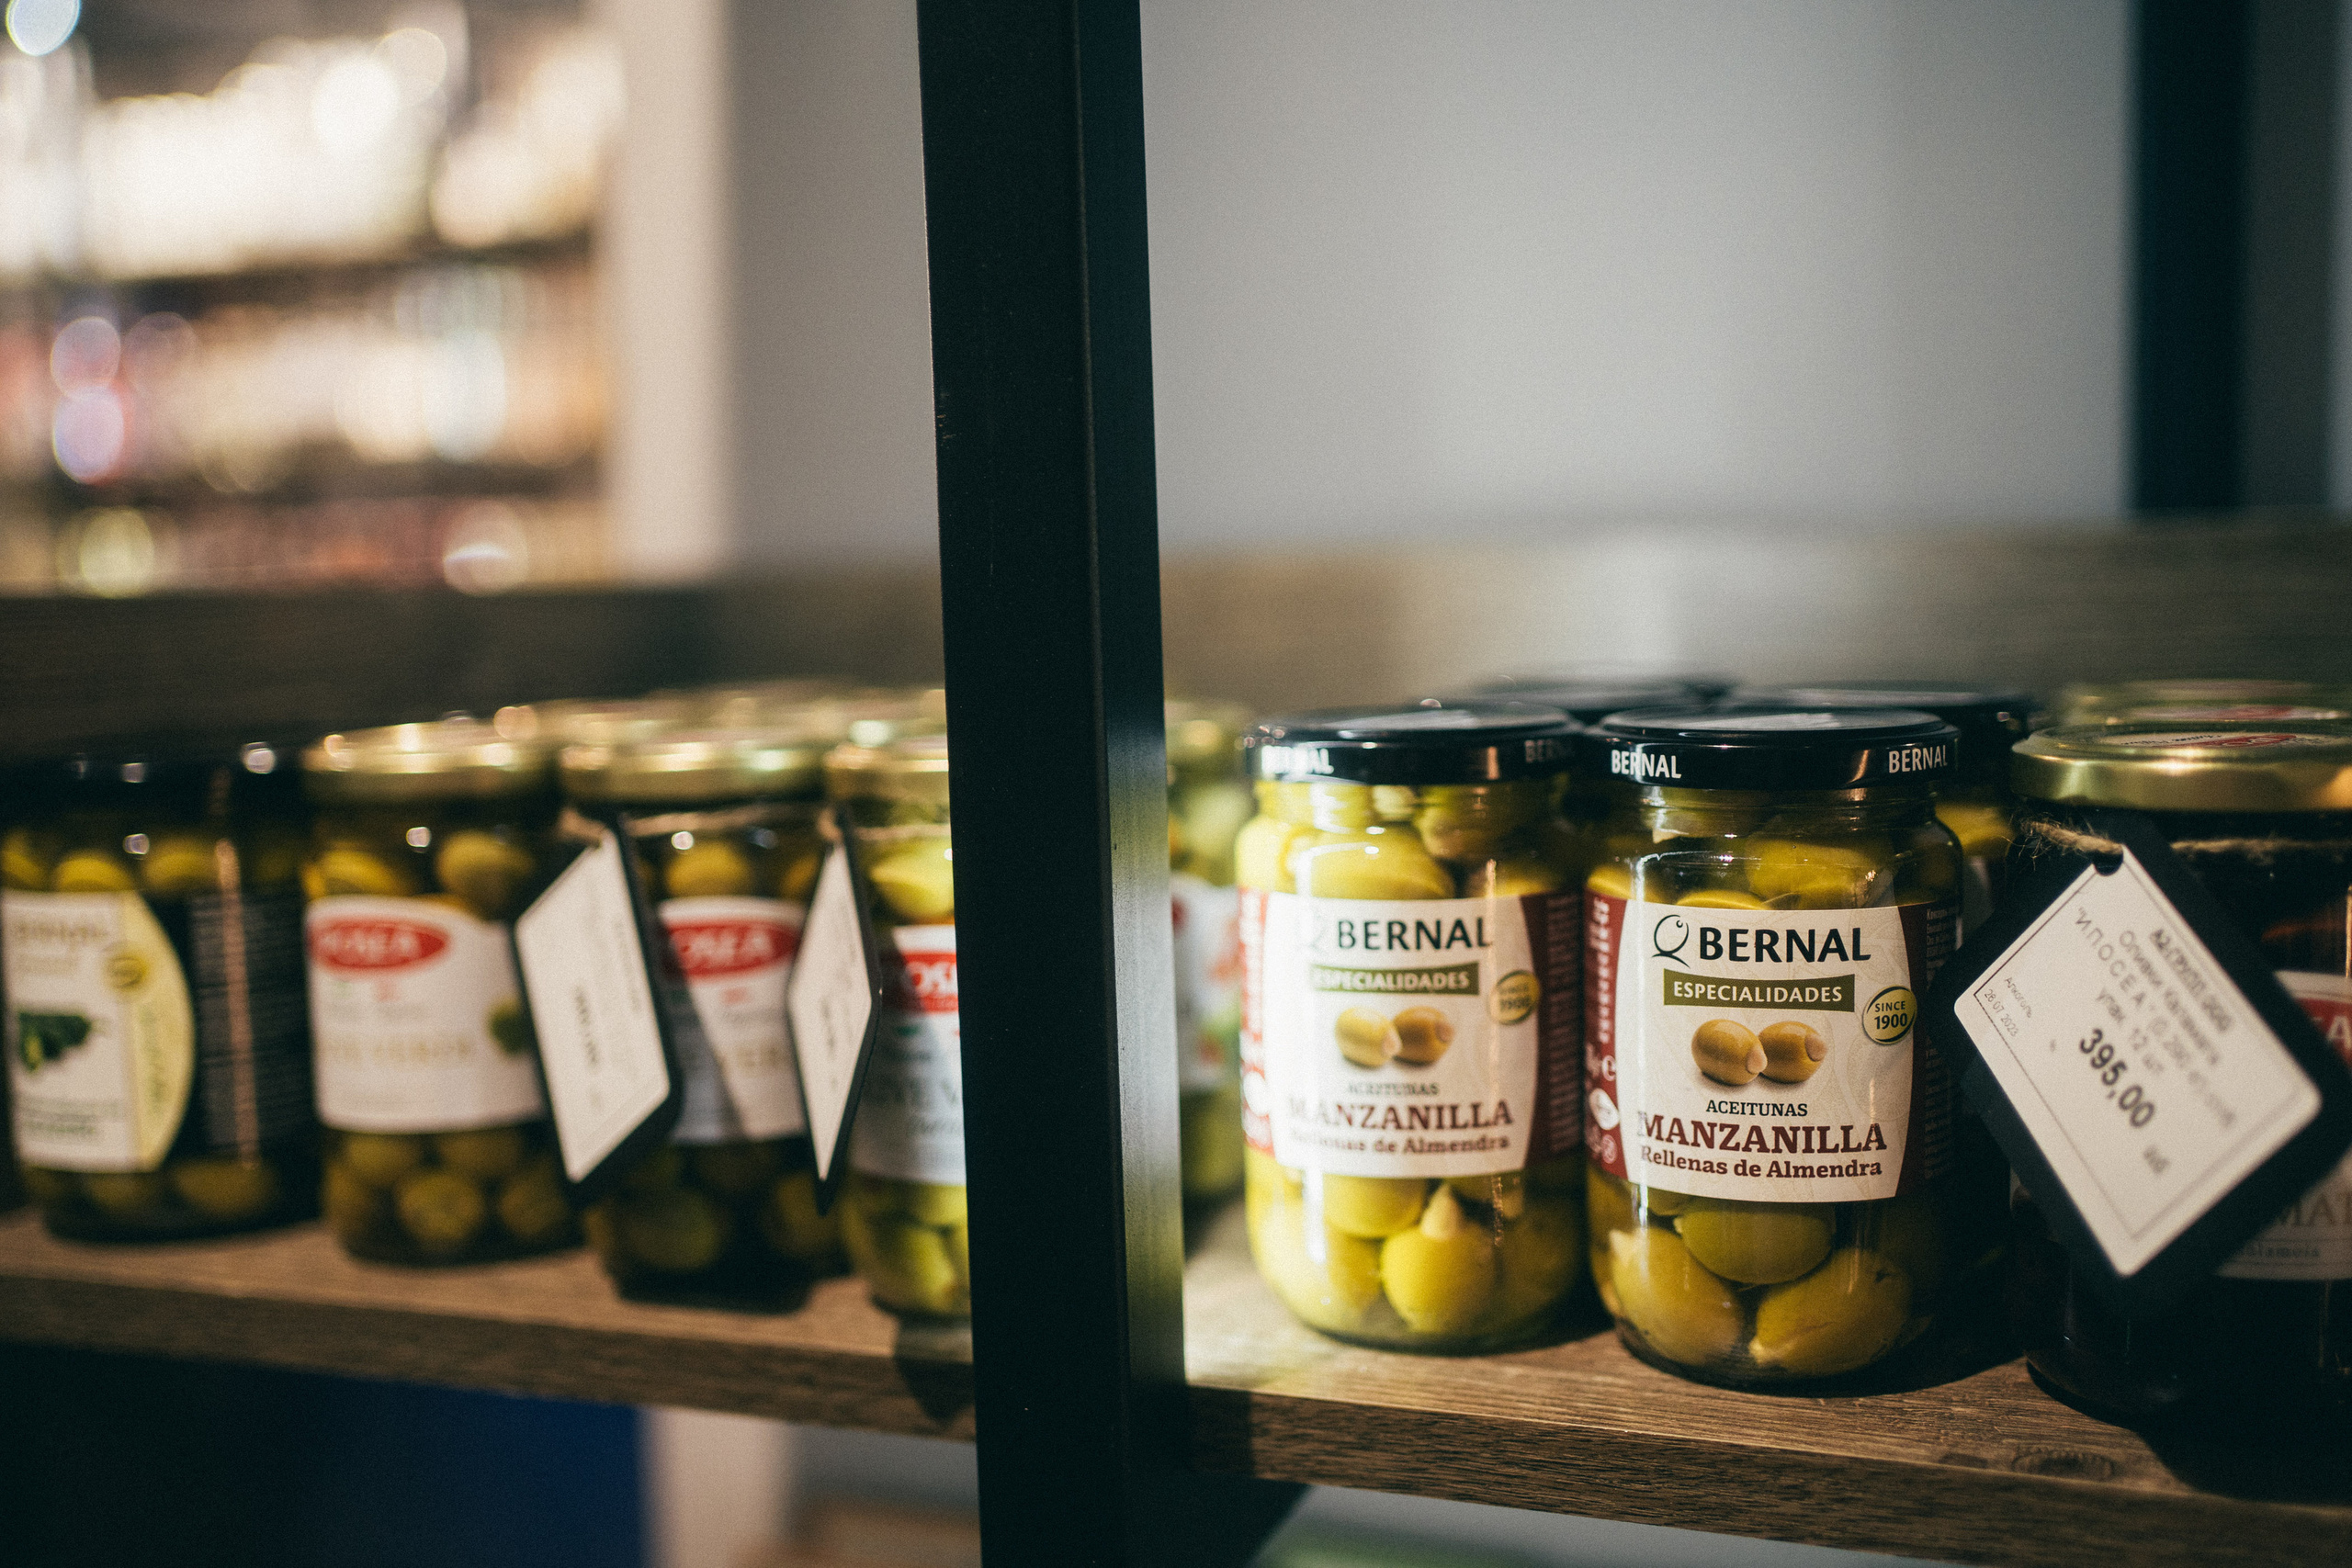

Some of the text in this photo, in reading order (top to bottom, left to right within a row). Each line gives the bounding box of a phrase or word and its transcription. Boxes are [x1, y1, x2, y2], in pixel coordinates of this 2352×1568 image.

[1611, 749, 1681, 779] BERNAL
[1888, 744, 1949, 774] BERNAL
[1337, 916, 1494, 952] BERNAL
[1698, 926, 1871, 964] BERNAL
[1673, 980, 1843, 1004] ESPECIALIDADES
[1873, 999, 1906, 1012] SINCE
[1873, 1012, 1908, 1031] 1900
[2078, 1027, 2154, 1128] 395,00
[1705, 1099, 1808, 1117] ACEITUNAS
[1636, 1110, 1888, 1155] MANZANILLA
[1640, 1144, 1883, 1179] Rellenas de Almendra
